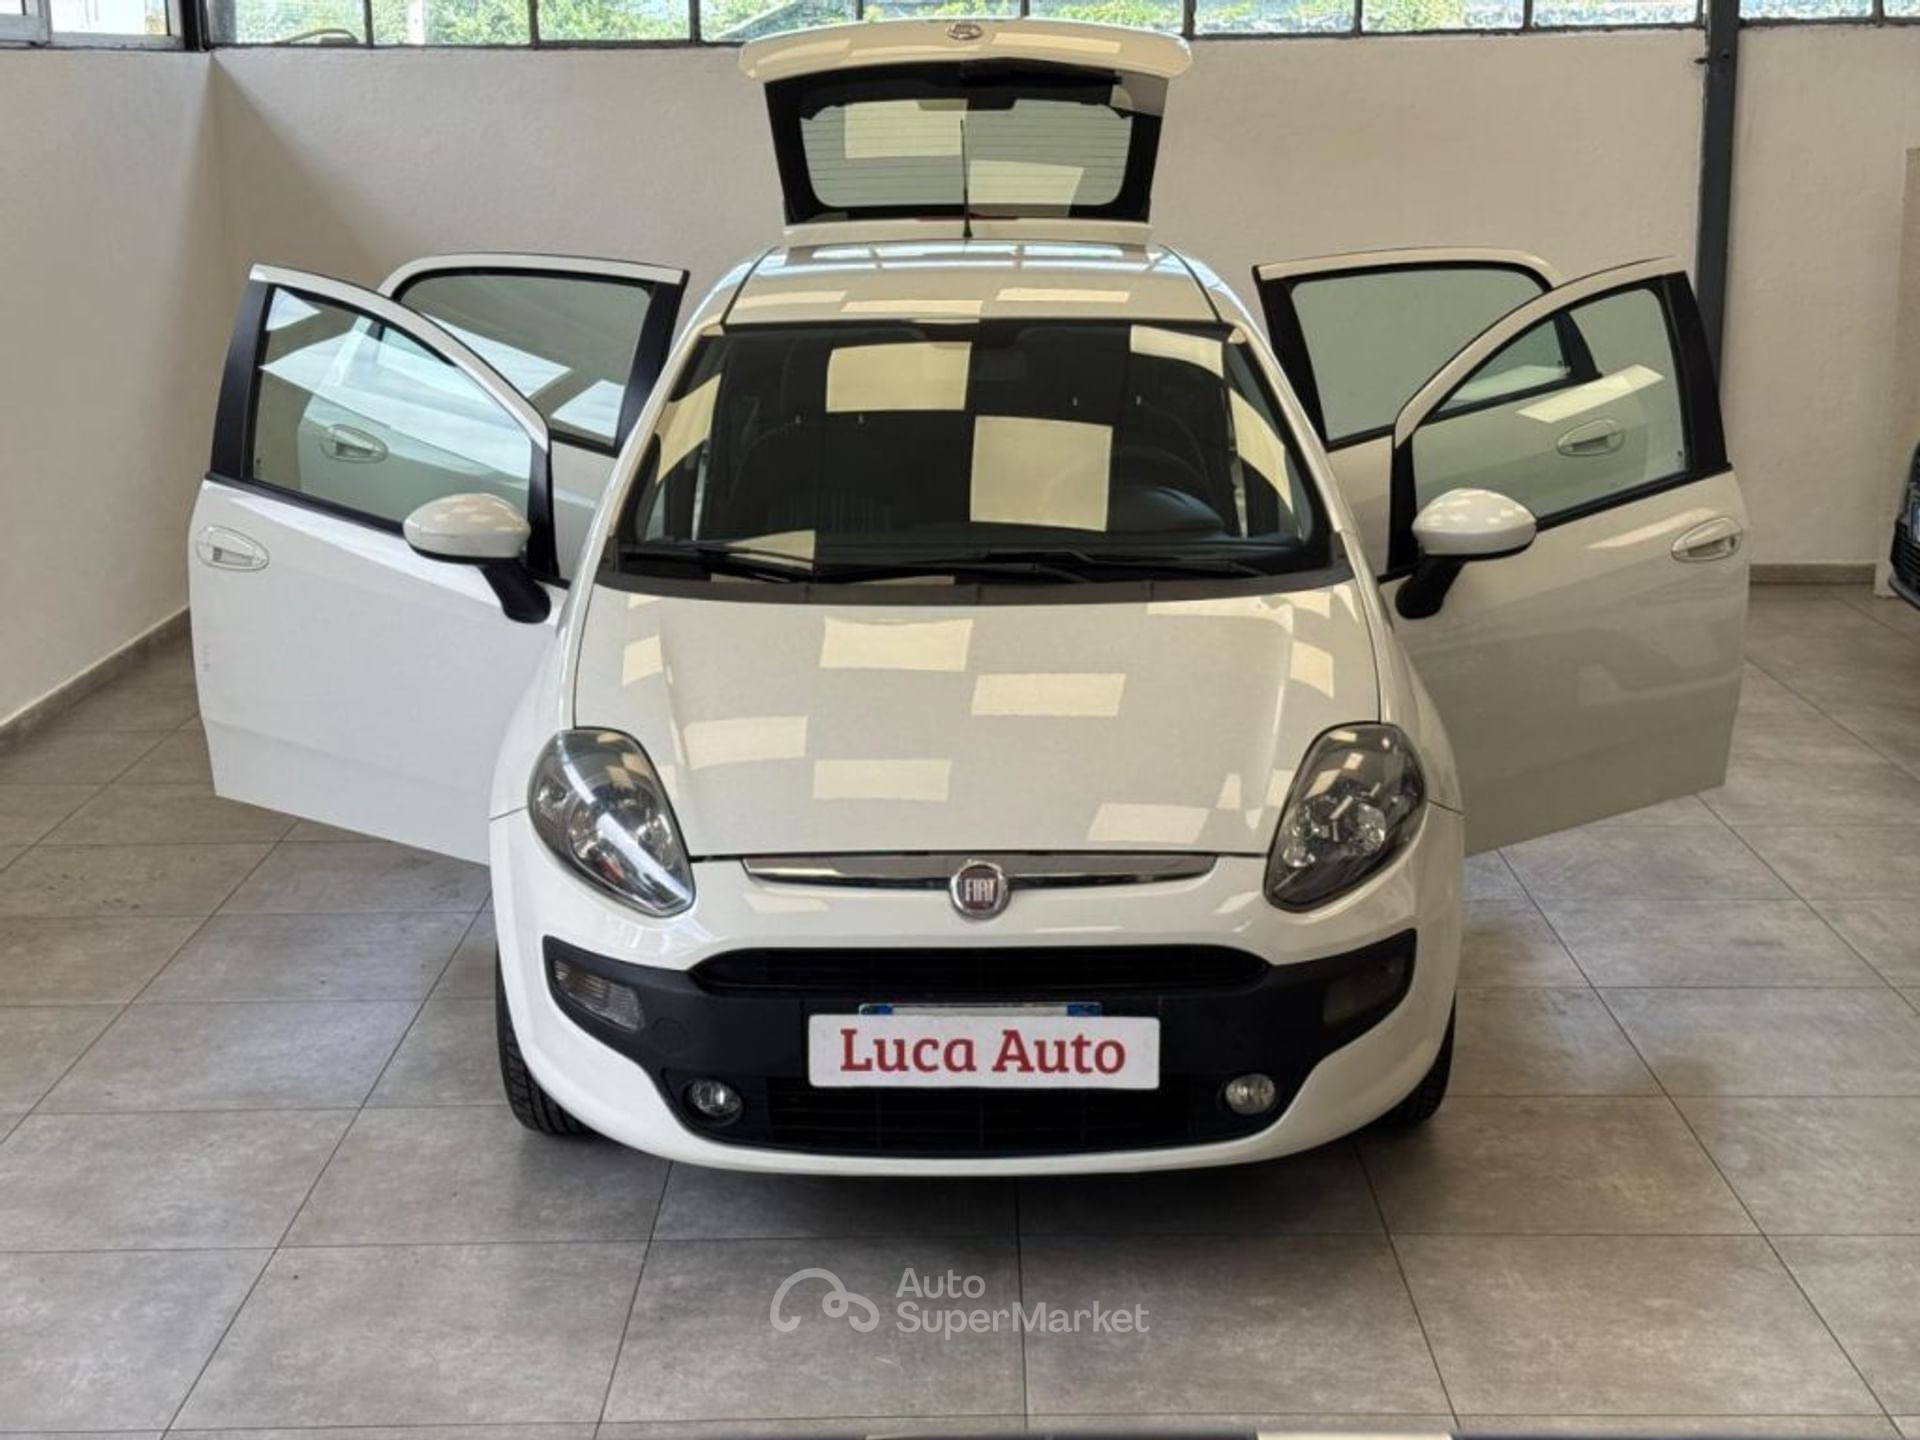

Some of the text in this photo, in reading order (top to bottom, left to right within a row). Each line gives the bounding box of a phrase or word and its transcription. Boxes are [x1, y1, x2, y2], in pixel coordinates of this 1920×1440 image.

[965, 878, 995, 901] FIAT
[840, 1028, 1126, 1074] Luca Auto
